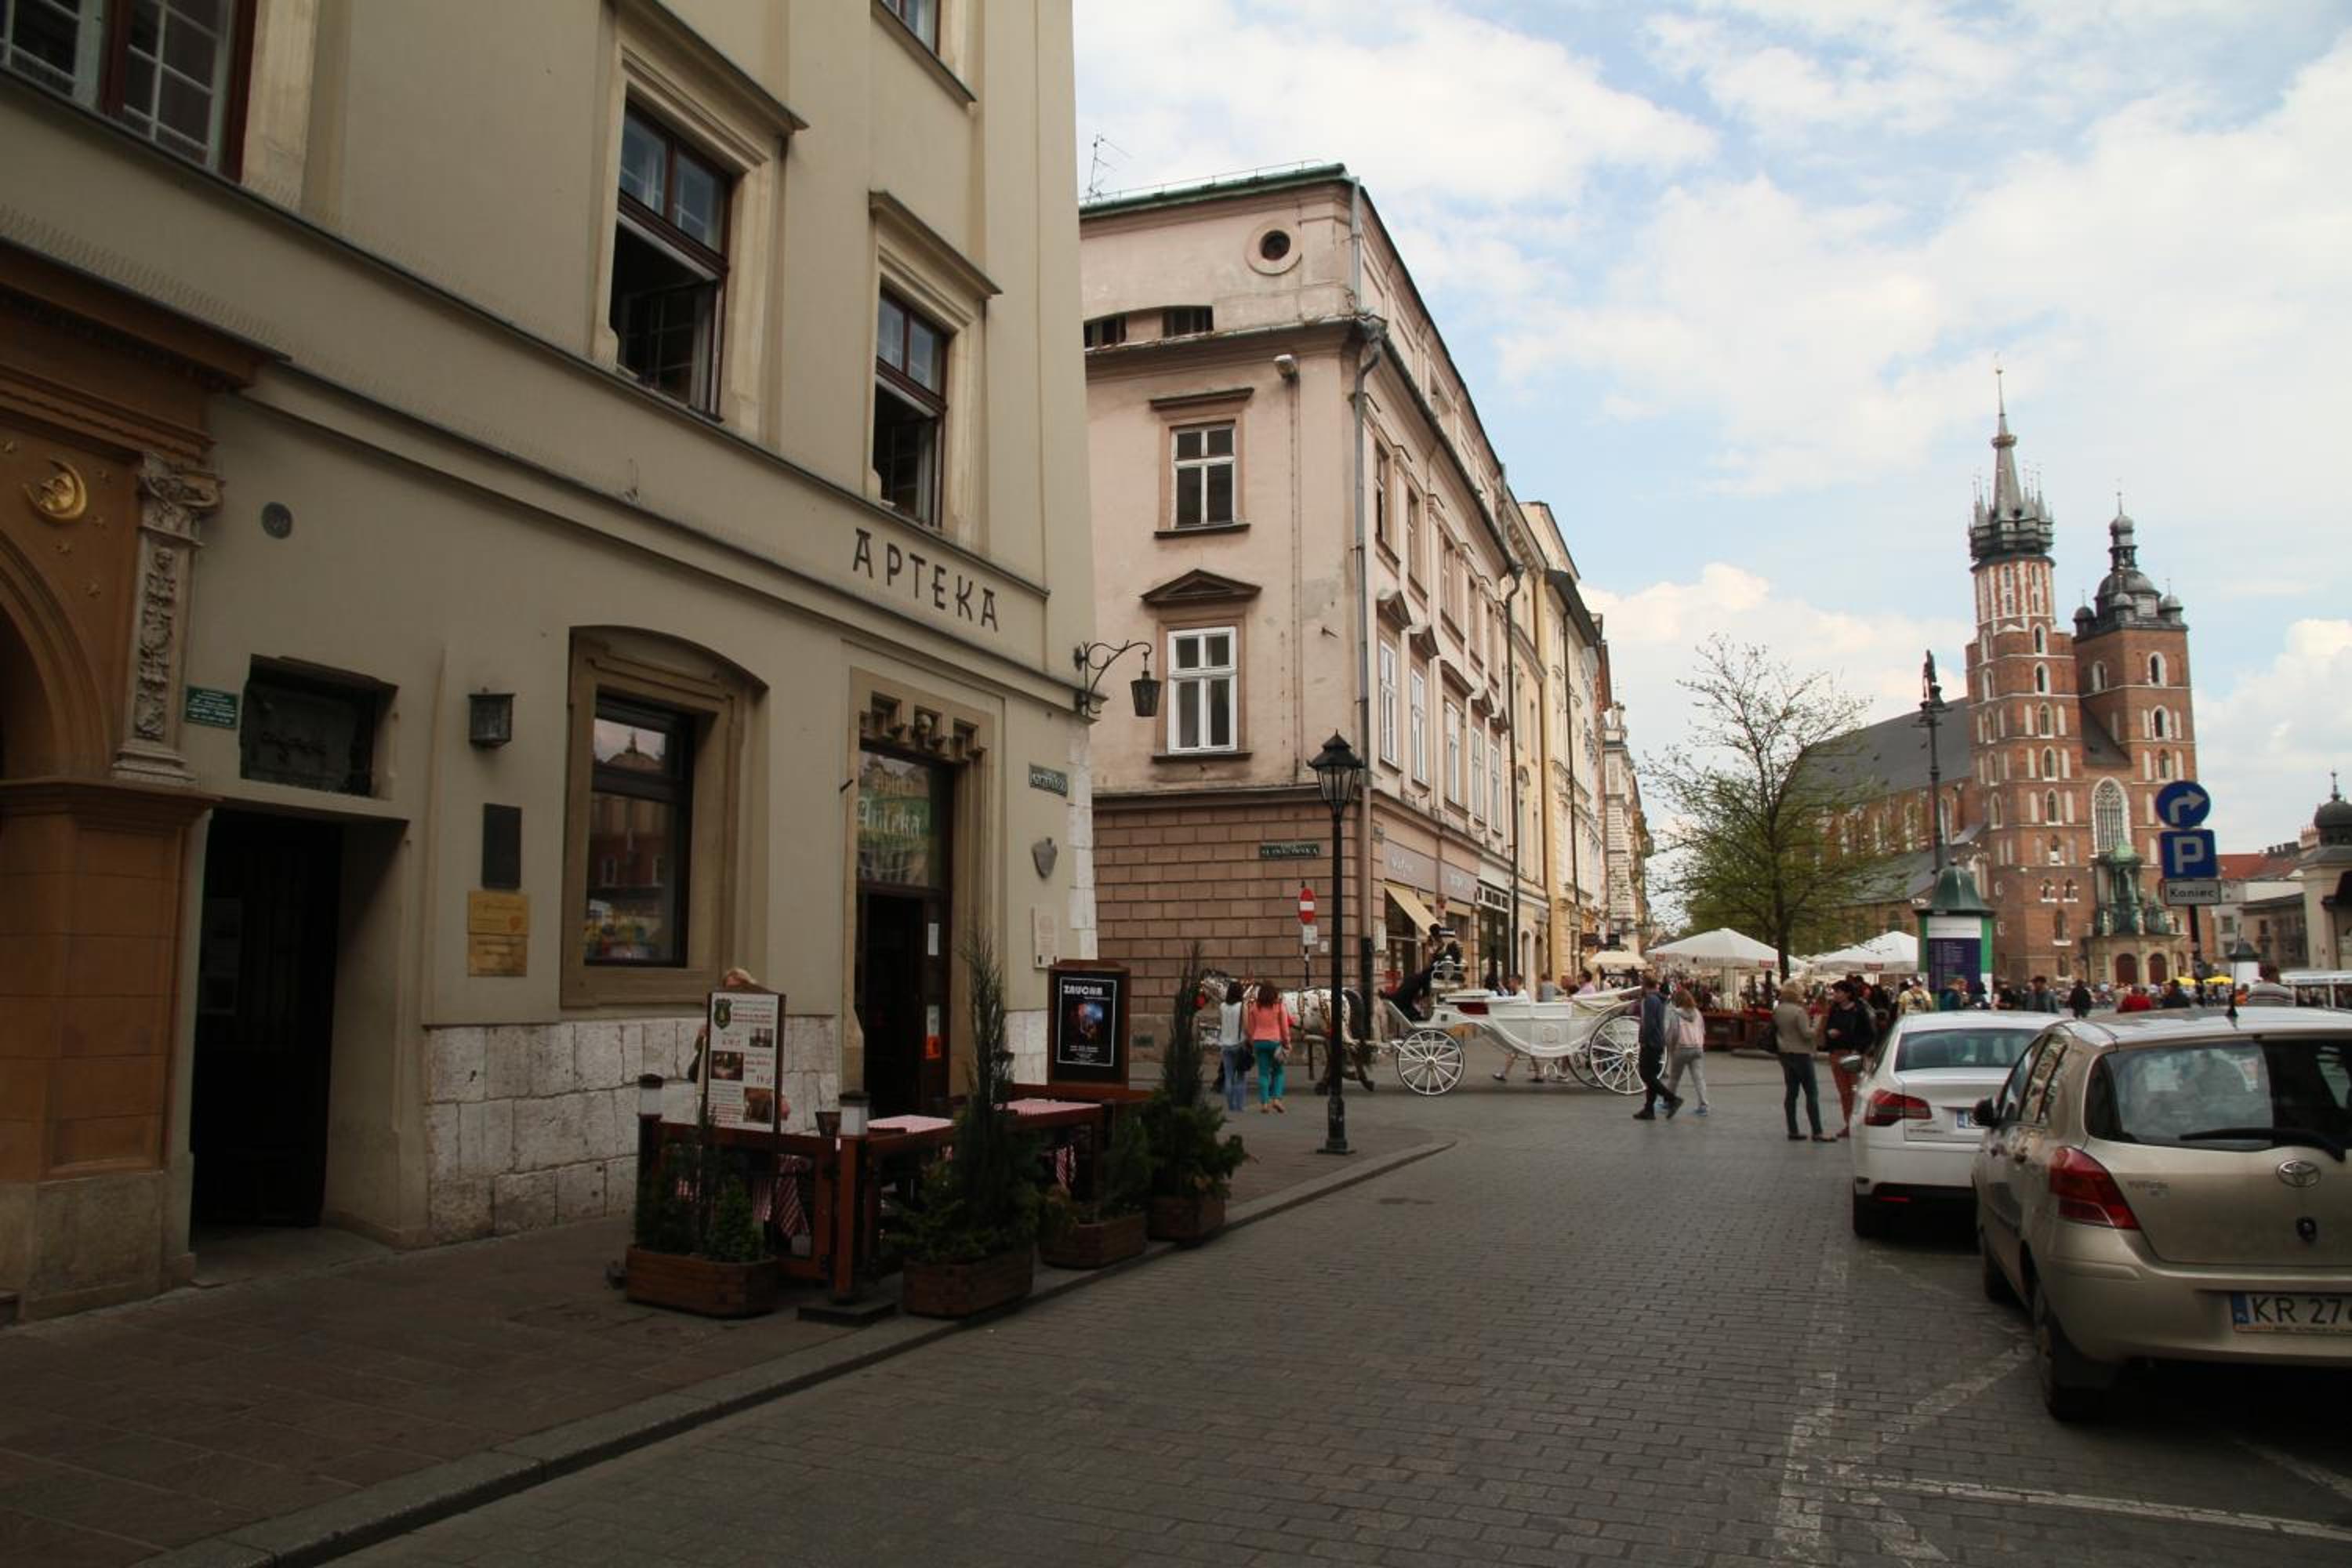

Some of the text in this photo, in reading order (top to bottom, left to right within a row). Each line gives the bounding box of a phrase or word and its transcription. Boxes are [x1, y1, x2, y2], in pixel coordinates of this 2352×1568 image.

[853, 528, 999, 632] APTEKA
[2173, 836, 2205, 874] P
[2252, 1297, 2297, 1323] KR
[2308, 1298, 2352, 1324] 27
